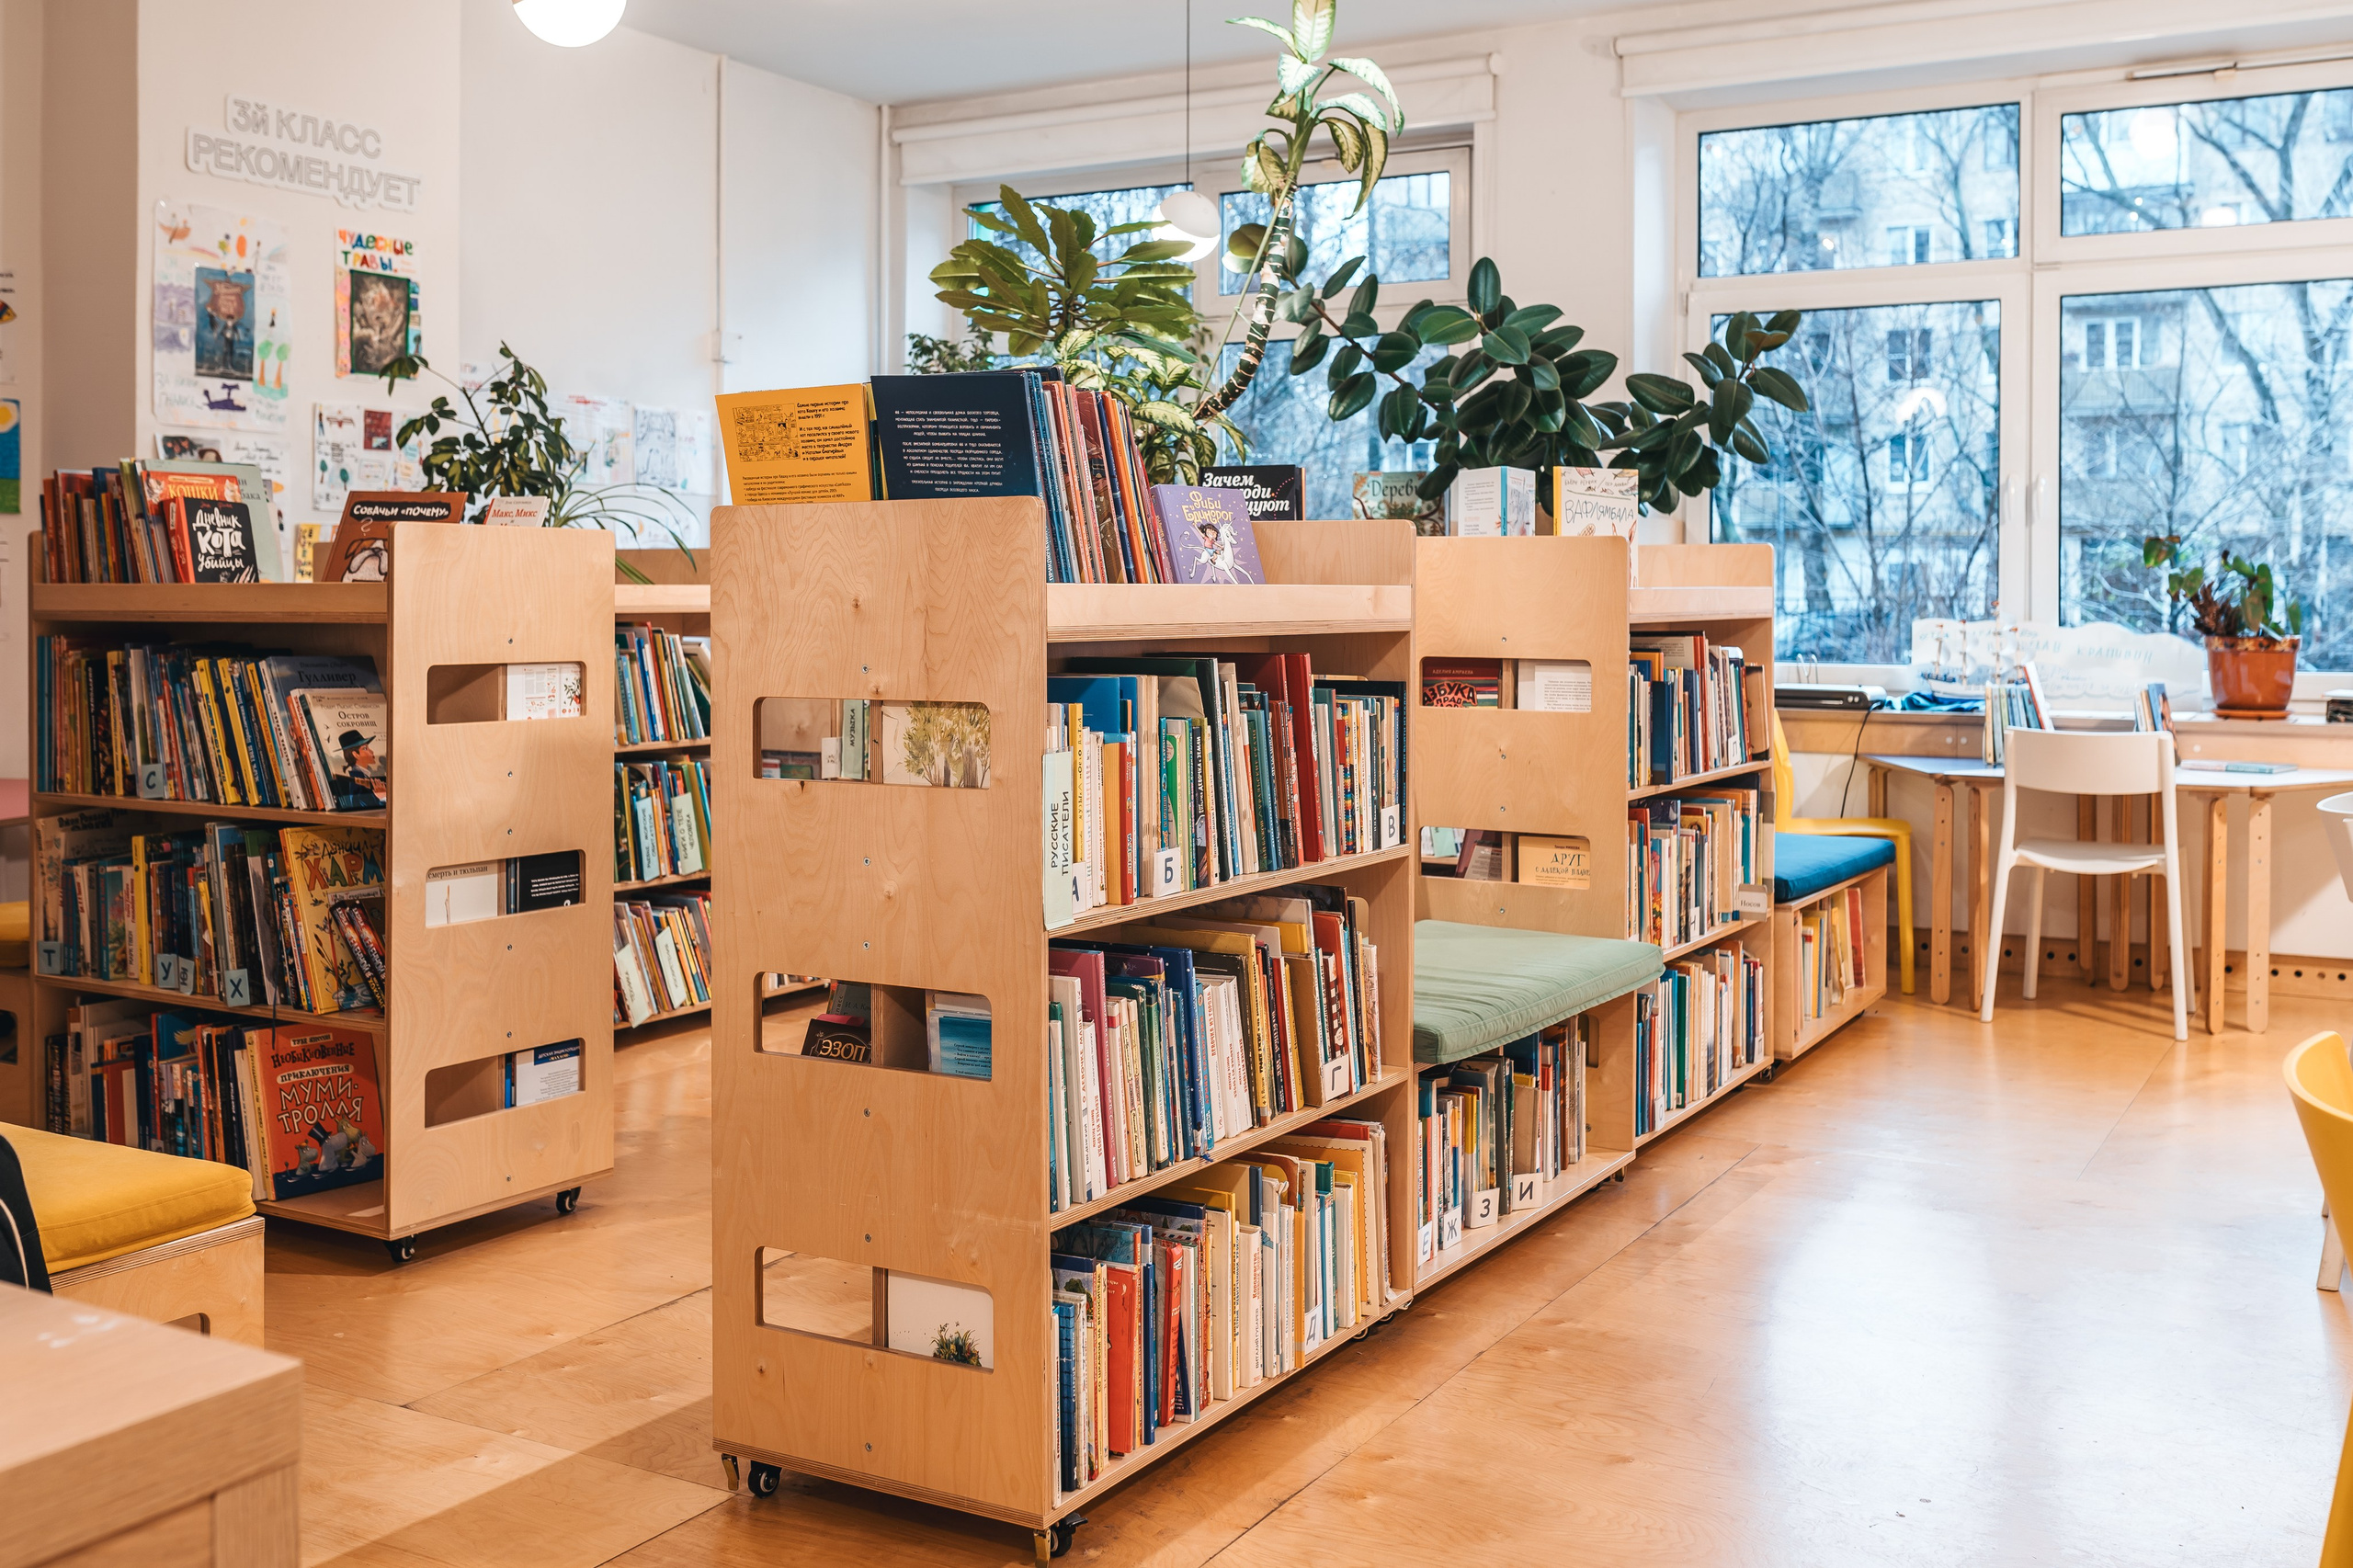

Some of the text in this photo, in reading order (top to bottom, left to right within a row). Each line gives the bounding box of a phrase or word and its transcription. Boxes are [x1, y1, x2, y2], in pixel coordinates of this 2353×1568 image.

[277, 108, 381, 159] КЛАСС
[193, 133, 421, 206] РЕКОМЕНДУЕТ
[1202, 472, 1255, 488] Зачем
[1368, 478, 1419, 503] Дерев
[168, 483, 219, 501] КОШКИ
[1189, 490, 1221, 510] Фиби
[1244, 484, 1271, 500] юди
[192, 506, 242, 531] Дневник
[401, 505, 449, 517] «ПОЧЕМУ»
[492, 508, 538, 518] Макс, Микс
[1182, 505, 1233, 524] Единорог
[1246, 500, 1290, 517] цуют
[1564, 499, 1634, 524] ВАФЛЯМБАЛА
[198, 552, 244, 572] убийцы
[298, 670, 357, 685] Гулливер
[1423, 682, 1477, 706] АЗБУКА
[144, 770, 157, 790] С
[1051, 802, 1059, 869] РУССКИЕ
[1389, 814, 1395, 838] В
[304, 849, 386, 891] ХАРМ
[1164, 856, 1174, 884] Б
[1551, 852, 1586, 867] ДРУГ
[427, 869, 452, 881] смерть
[460, 865, 488, 876] тюльпан
[1072, 875, 1080, 903] А
[43, 949, 56, 967] Т
[161, 960, 172, 981] У
[230, 977, 244, 999] Х
[820, 1039, 866, 1062] ЭЗОП
[280, 1064, 350, 1083] ПРИКЛЮЧЕНИЯ
[1332, 1064, 1343, 1092] Г
[277, 1096, 364, 1135] ТРОЛЛЯ
[1518, 1180, 1534, 1201] И
[1479, 1198, 1491, 1219] З
[1447, 1217, 1459, 1242] Ж
[1422, 1231, 1430, 1256] Е
[1305, 1313, 1318, 1346] Д
